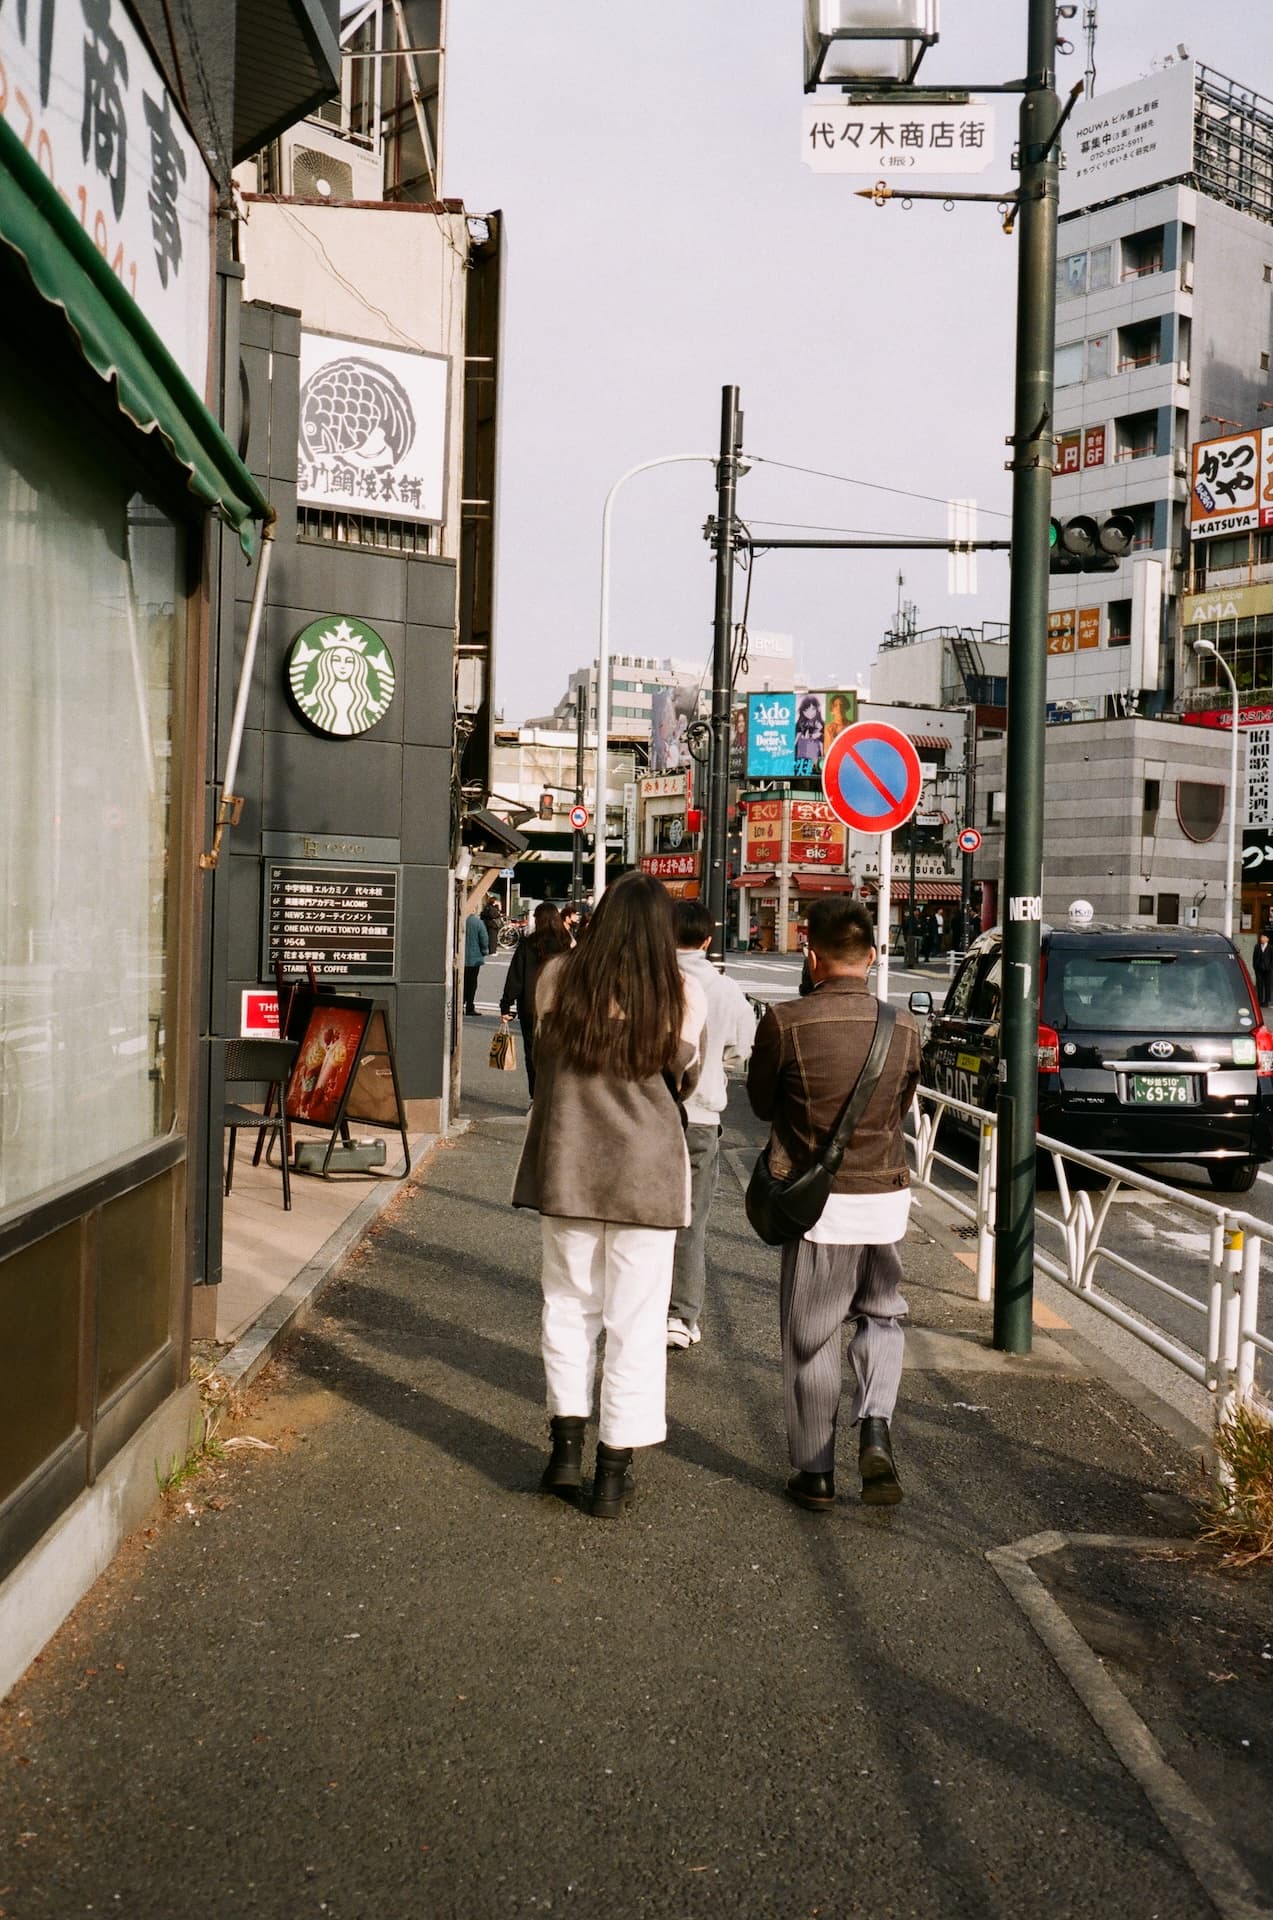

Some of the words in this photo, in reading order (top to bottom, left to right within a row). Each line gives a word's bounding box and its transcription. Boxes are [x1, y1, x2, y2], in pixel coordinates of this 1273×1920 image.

[810, 121, 985, 149] 代々木商店街
[1087, 448, 1103, 464] 6F
[1192, 601, 1238, 621] AMA
[865, 863, 906, 873] BARY
[916, 866, 956, 876] BURGR
[315, 884, 349, 895] エルカミノ
[284, 911, 304, 919] NEWS
[305, 912, 373, 921] エンターテインメント
[338, 926, 360, 934] TOKYO
[284, 938, 305, 946] りらくる
[1162, 1078, 1177, 1086] 510
[1146, 1087, 1186, 1101] 69-78
